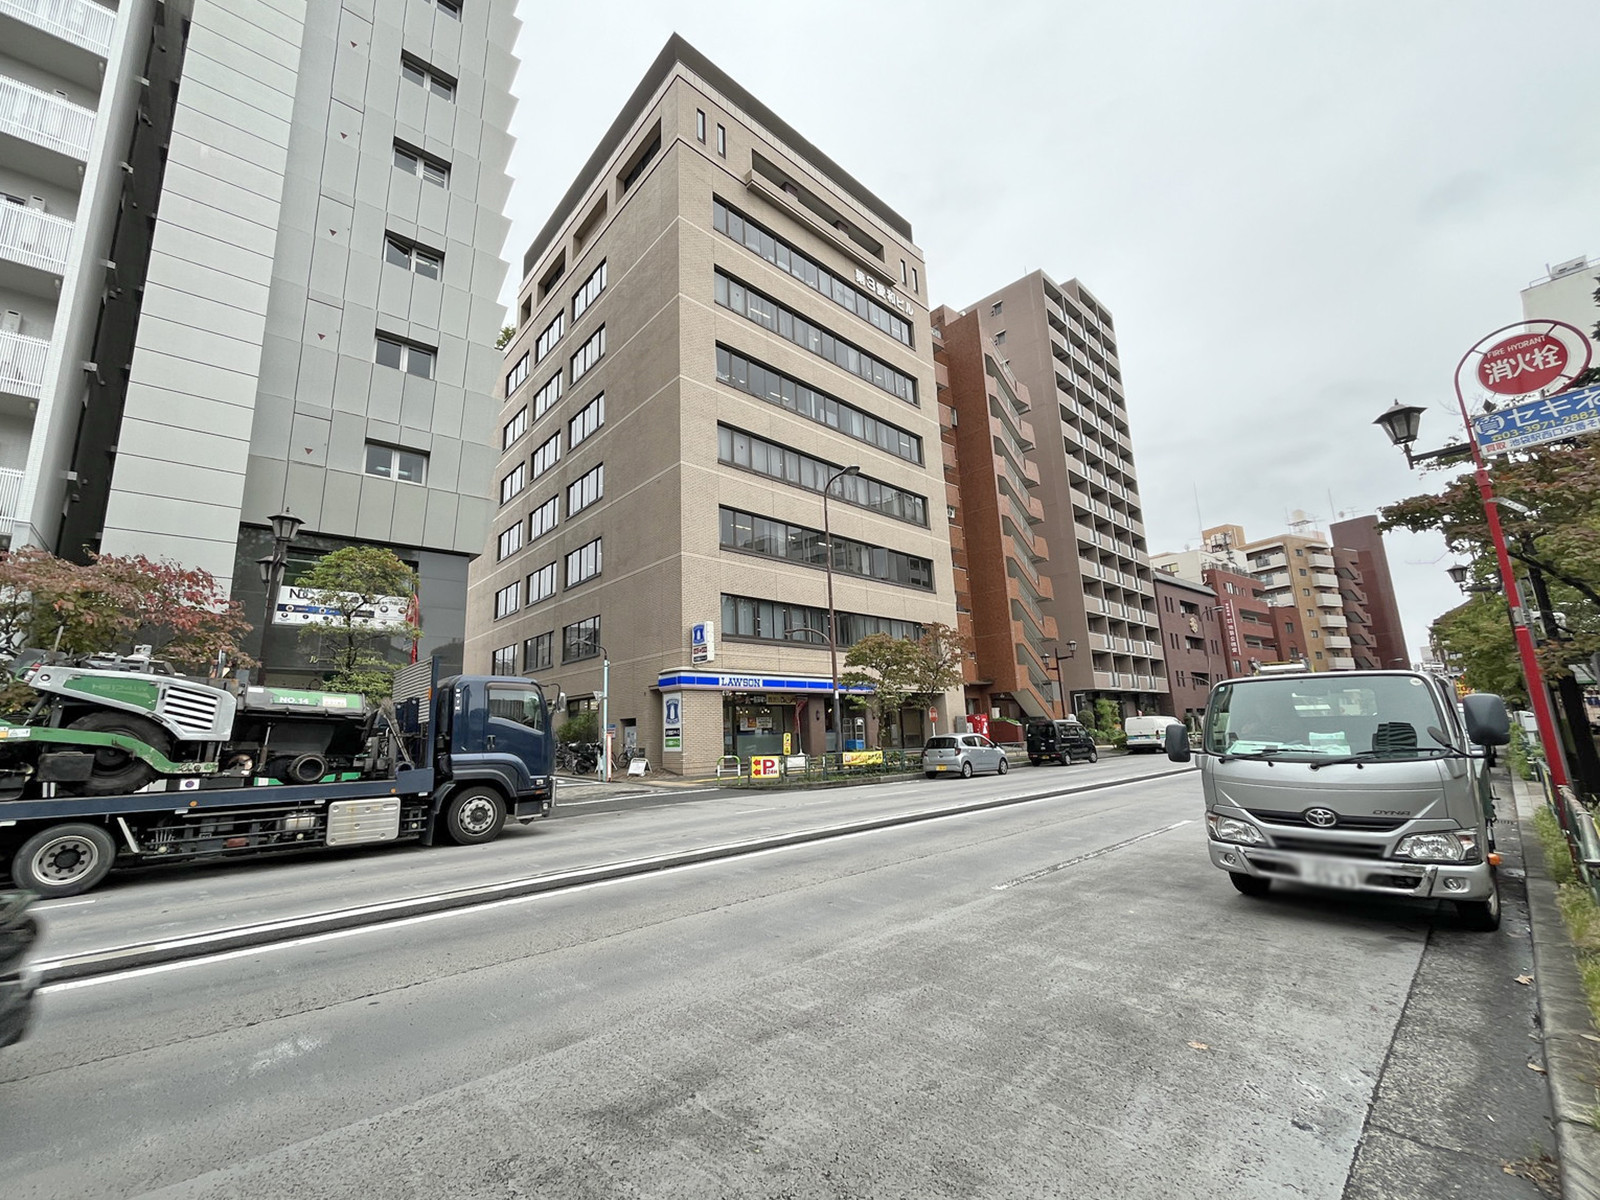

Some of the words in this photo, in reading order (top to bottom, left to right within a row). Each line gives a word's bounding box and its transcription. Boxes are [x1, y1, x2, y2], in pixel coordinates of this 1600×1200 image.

[1487, 347, 1505, 359] FIRE
[1508, 336, 1546, 353] HYDRANT
[1484, 345, 1563, 385] 消火栓
[1501, 408, 1599, 440] 03-3971-2882
[1510, 420, 1600, 447] 池袋駅西口交番そ
[721, 677, 761, 688] LAWSON
[762, 759, 775, 775] P
